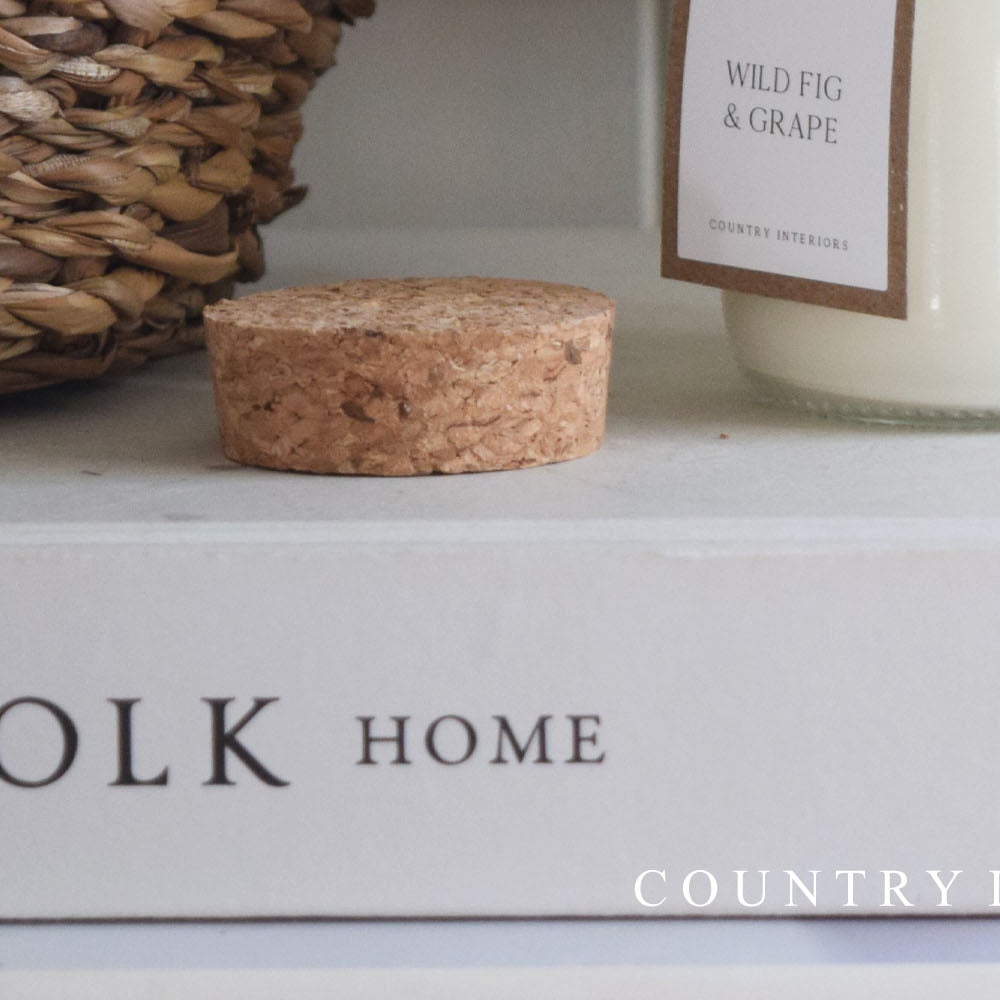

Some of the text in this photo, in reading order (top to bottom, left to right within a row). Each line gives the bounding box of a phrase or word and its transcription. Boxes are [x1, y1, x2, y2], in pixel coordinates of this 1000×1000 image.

[726, 59, 843, 102] WILD FIG
[723, 102, 838, 144] & GRAPE
[708, 218, 849, 251] COUNTRY INTERIORS
[0, 695, 607, 788] OLK HOME
